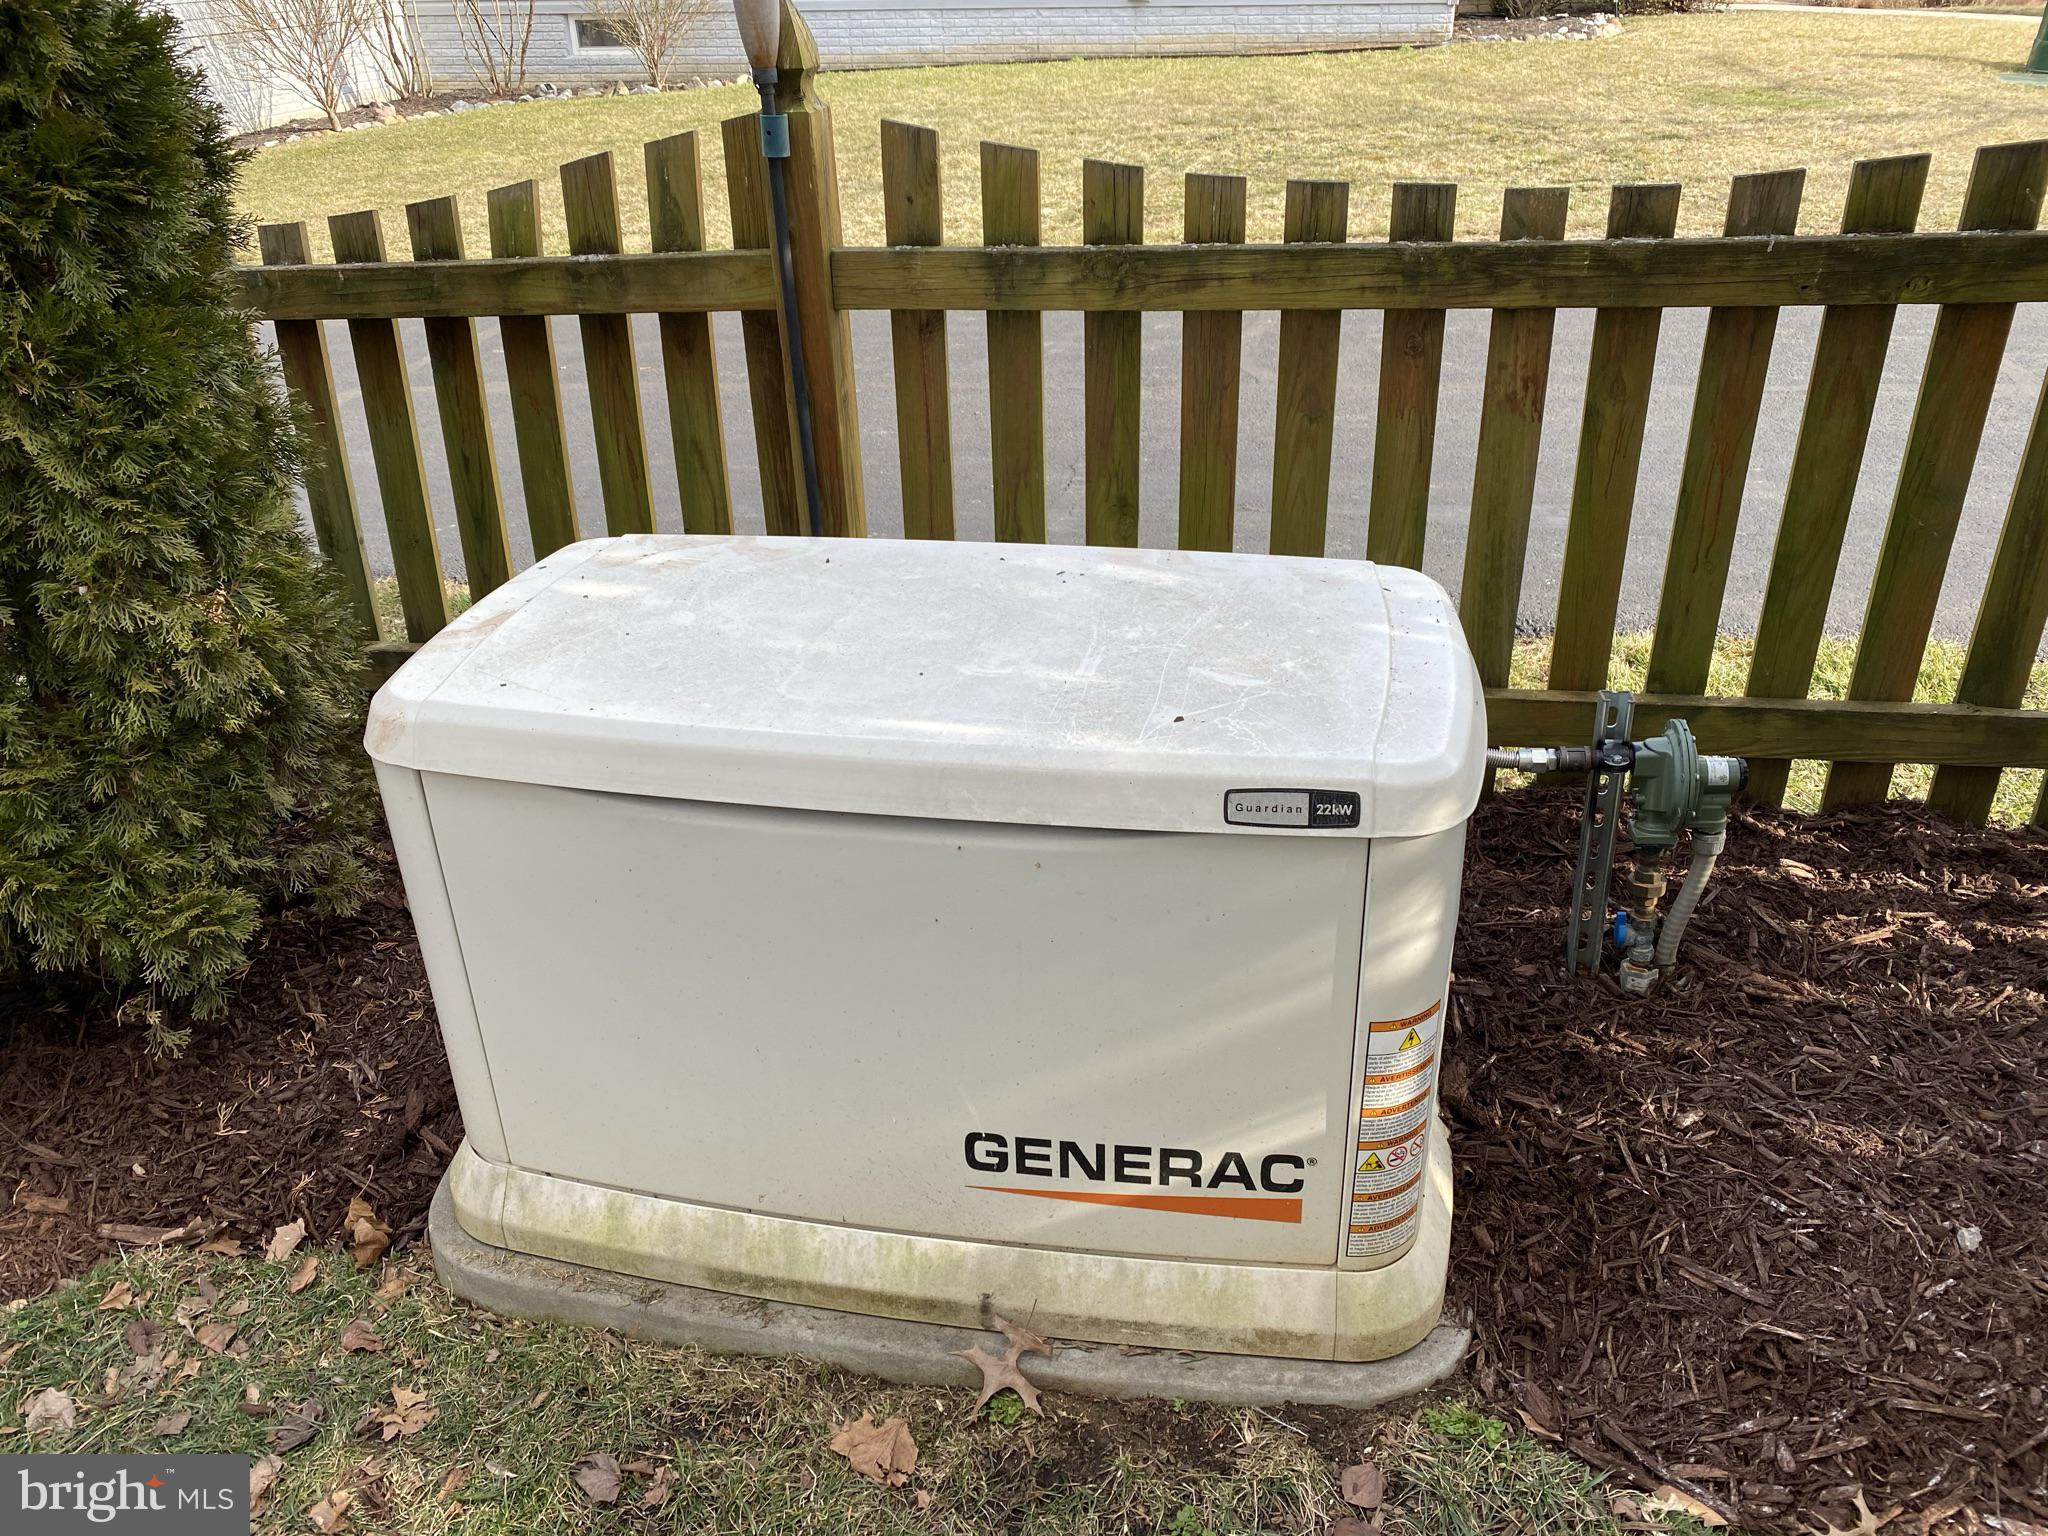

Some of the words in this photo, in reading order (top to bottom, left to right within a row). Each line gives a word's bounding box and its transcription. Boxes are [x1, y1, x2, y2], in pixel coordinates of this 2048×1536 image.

[1235, 803, 1302, 814] Guardian
[1316, 804, 1353, 816] 22kW
[1400, 1010, 1432, 1027] WARNING
[964, 1131, 1305, 1194] GENERAC
